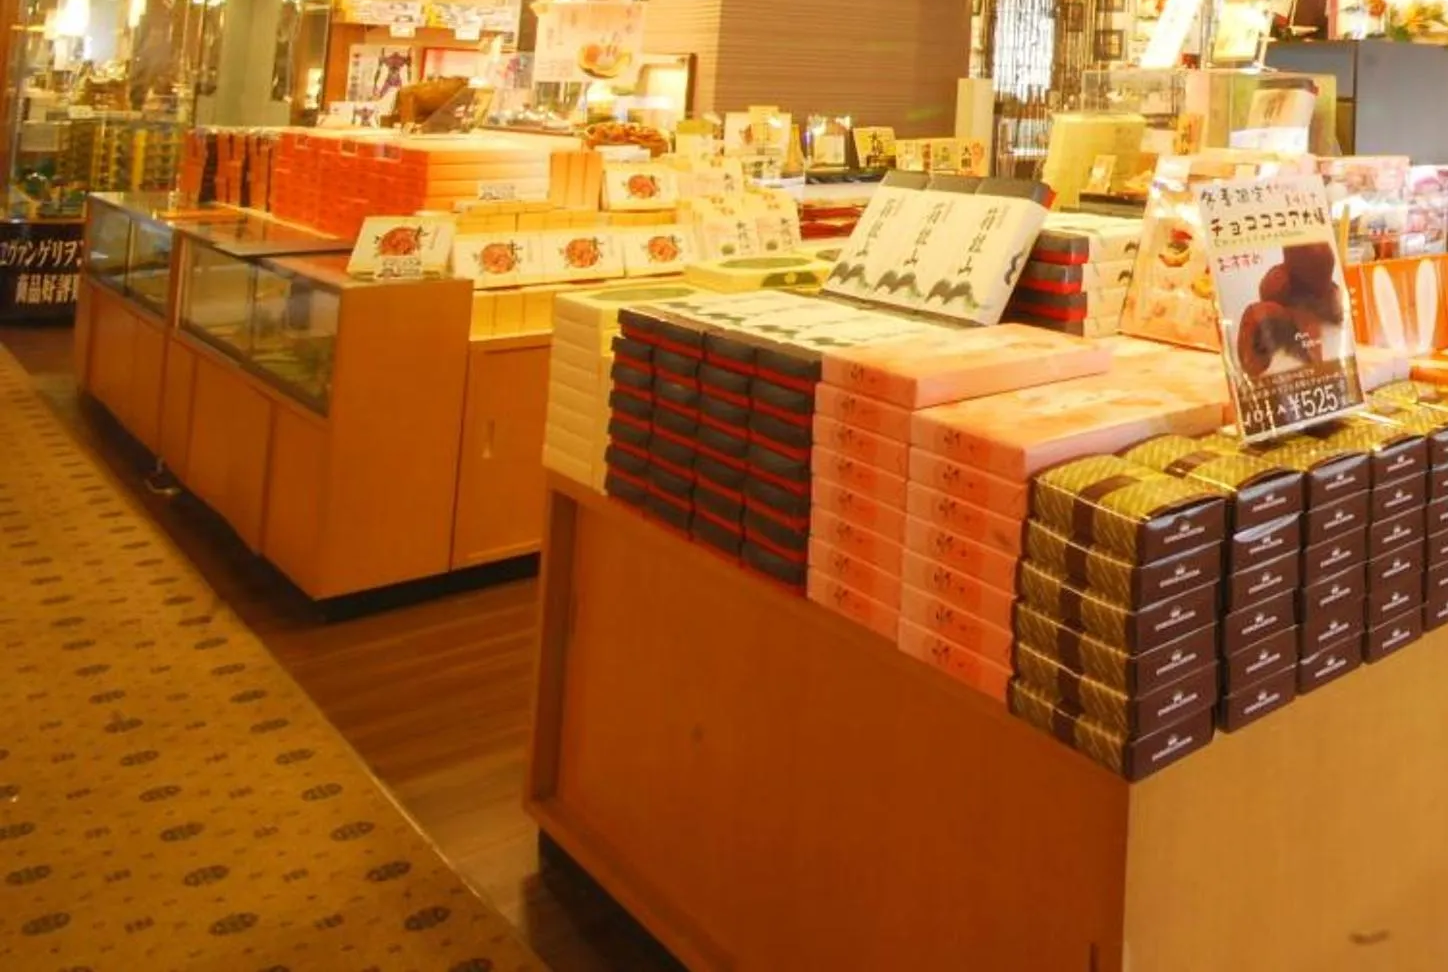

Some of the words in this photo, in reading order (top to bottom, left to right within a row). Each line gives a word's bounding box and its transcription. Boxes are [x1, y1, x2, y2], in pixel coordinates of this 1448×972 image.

[0, 238, 84, 267] エヴァンゲリヲ
[1288, 384, 1339, 420] ¥525
